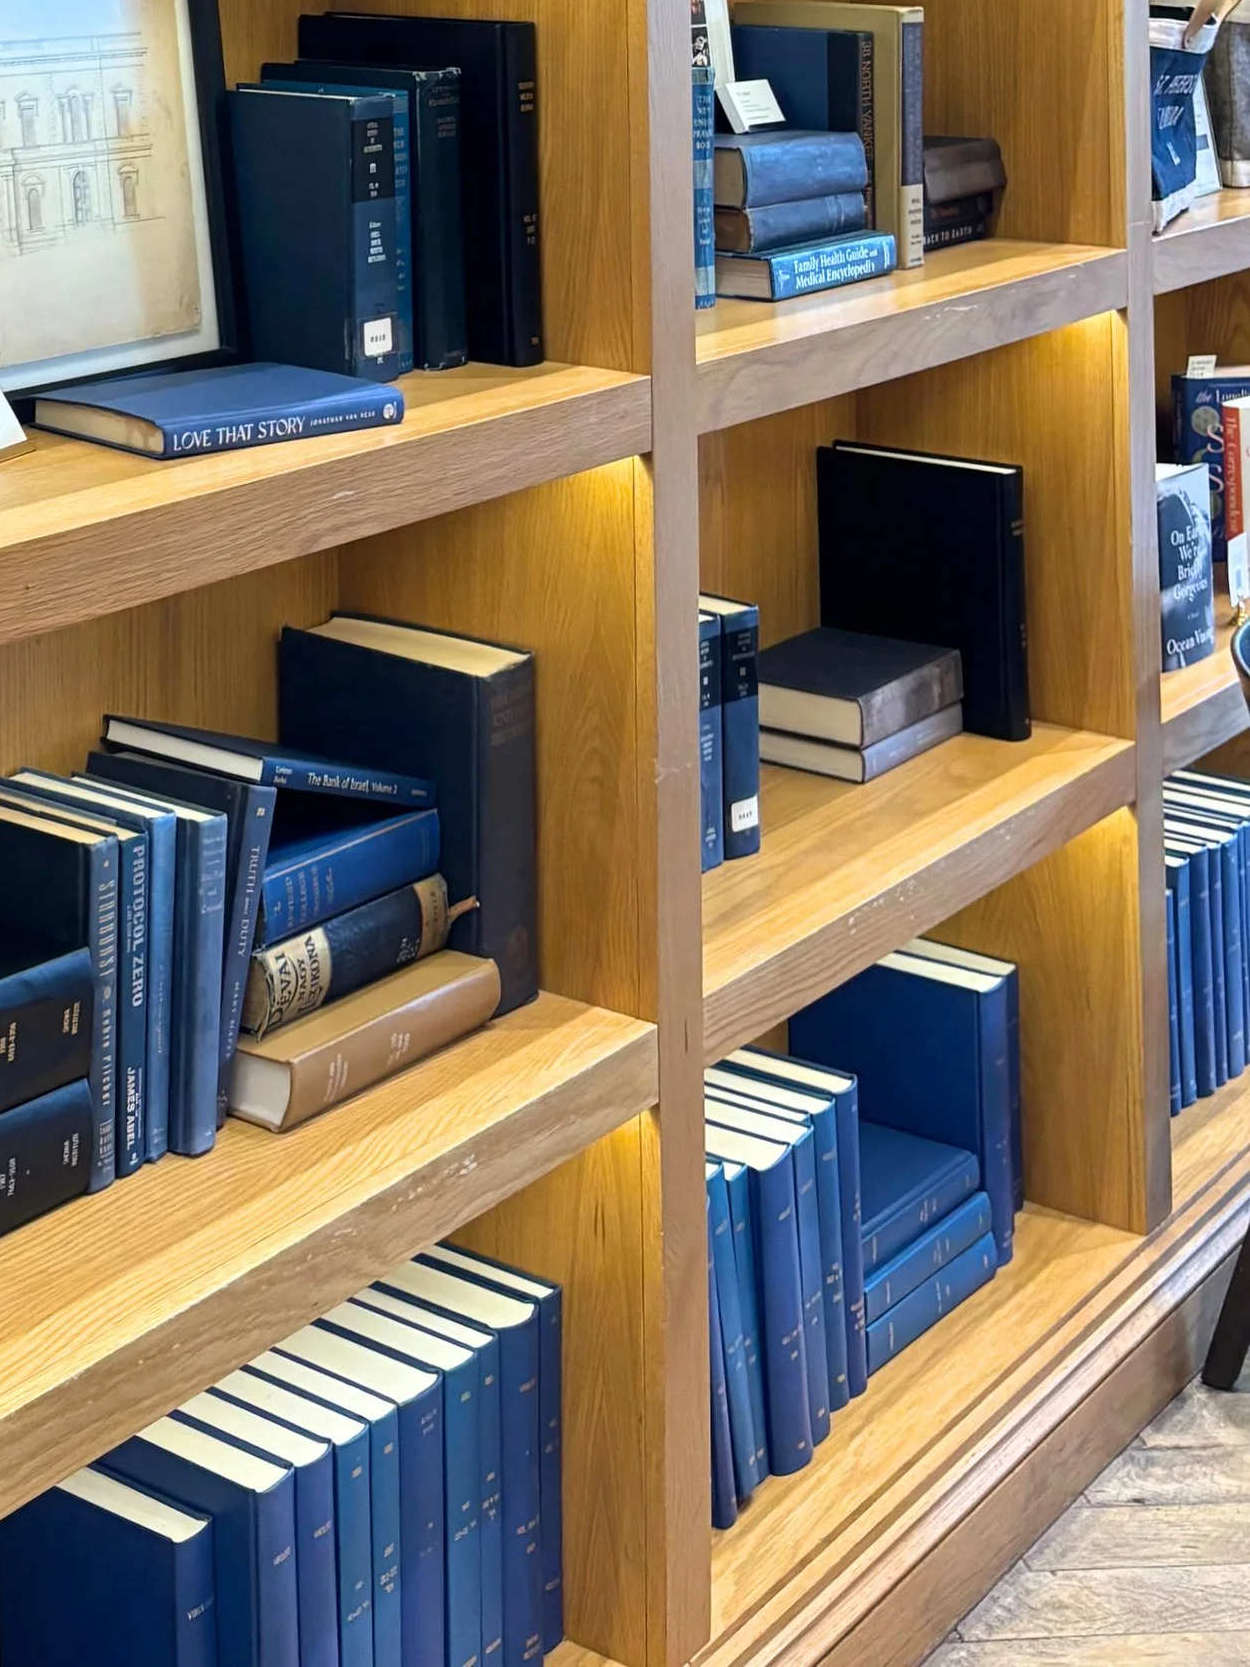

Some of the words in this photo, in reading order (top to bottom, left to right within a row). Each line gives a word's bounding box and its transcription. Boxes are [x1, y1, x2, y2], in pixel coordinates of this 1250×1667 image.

[861, 61, 872, 108] NORTH
[794, 257, 819, 274] Family
[820, 252, 846, 267] Health
[845, 246, 869, 260] Guide
[795, 271, 826, 289] Medical
[173, 429, 211, 451] LOVE
[216, 422, 254, 446] THAT
[257, 416, 306, 439] STORY
[1170, 530, 1185, 546] On
[1167, 634, 1195, 655] Ocean
[308, 772, 322, 786] The
[323, 774, 340, 789] Bank
[341, 777, 350, 788] of
[371, 782, 392, 793] Volume
[247, 846, 261, 894] TRUTH
[132, 844, 146, 952] PROTOCOL
[238, 918, 250, 957] DUTY
[132, 953, 146, 1007] ZERO
[232, 981, 240, 1013] MARY
[127, 1067, 136, 1113] JAMES
[126, 1115, 135, 1151] ABEL
